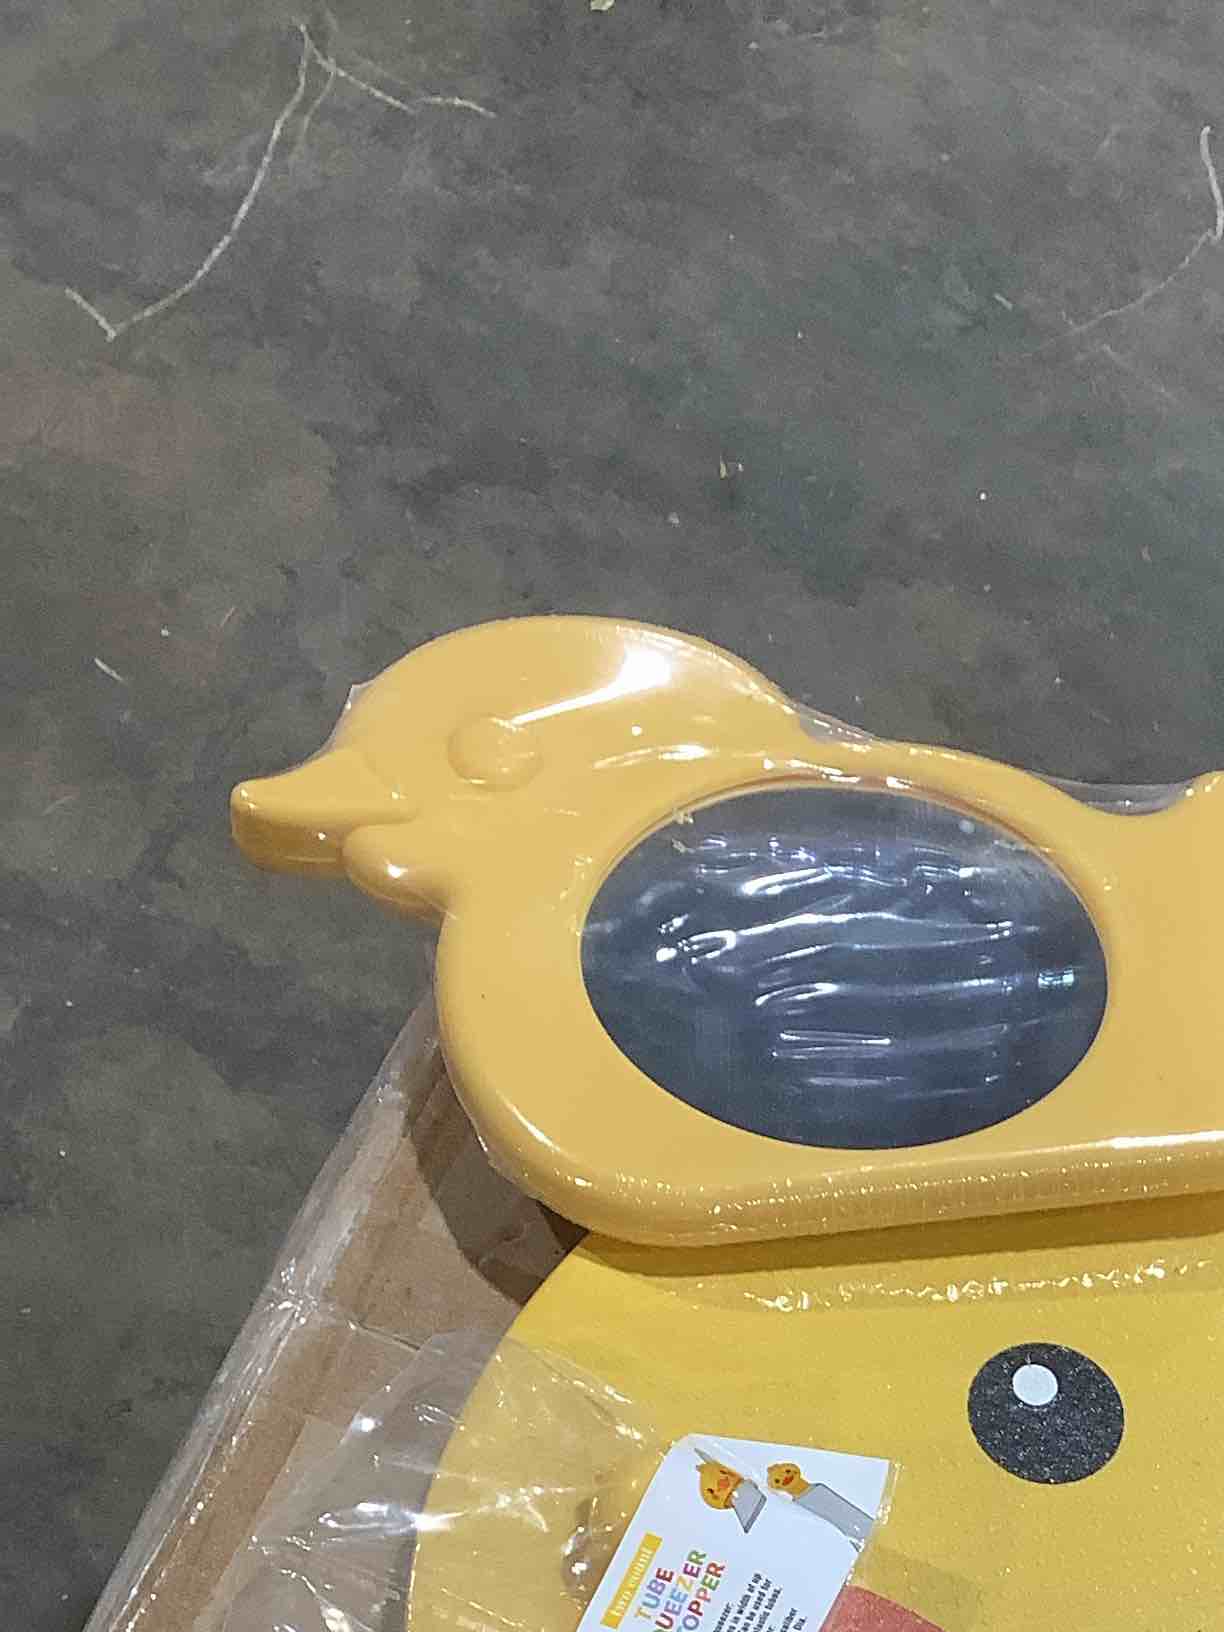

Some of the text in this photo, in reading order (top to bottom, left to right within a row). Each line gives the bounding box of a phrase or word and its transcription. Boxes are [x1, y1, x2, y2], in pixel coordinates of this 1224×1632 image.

[634, 1568, 674, 1618] TUBE
[729, 1616, 740, 1625] in
[737, 1594, 751, 1614] width
[747, 1583, 755, 1593] of
[752, 1573, 762, 1583] up
[746, 1611, 756, 1621] be
[752, 1590, 766, 1610] used
[760, 1579, 772, 1591] for
[780, 1607, 798, 1632] caliber
